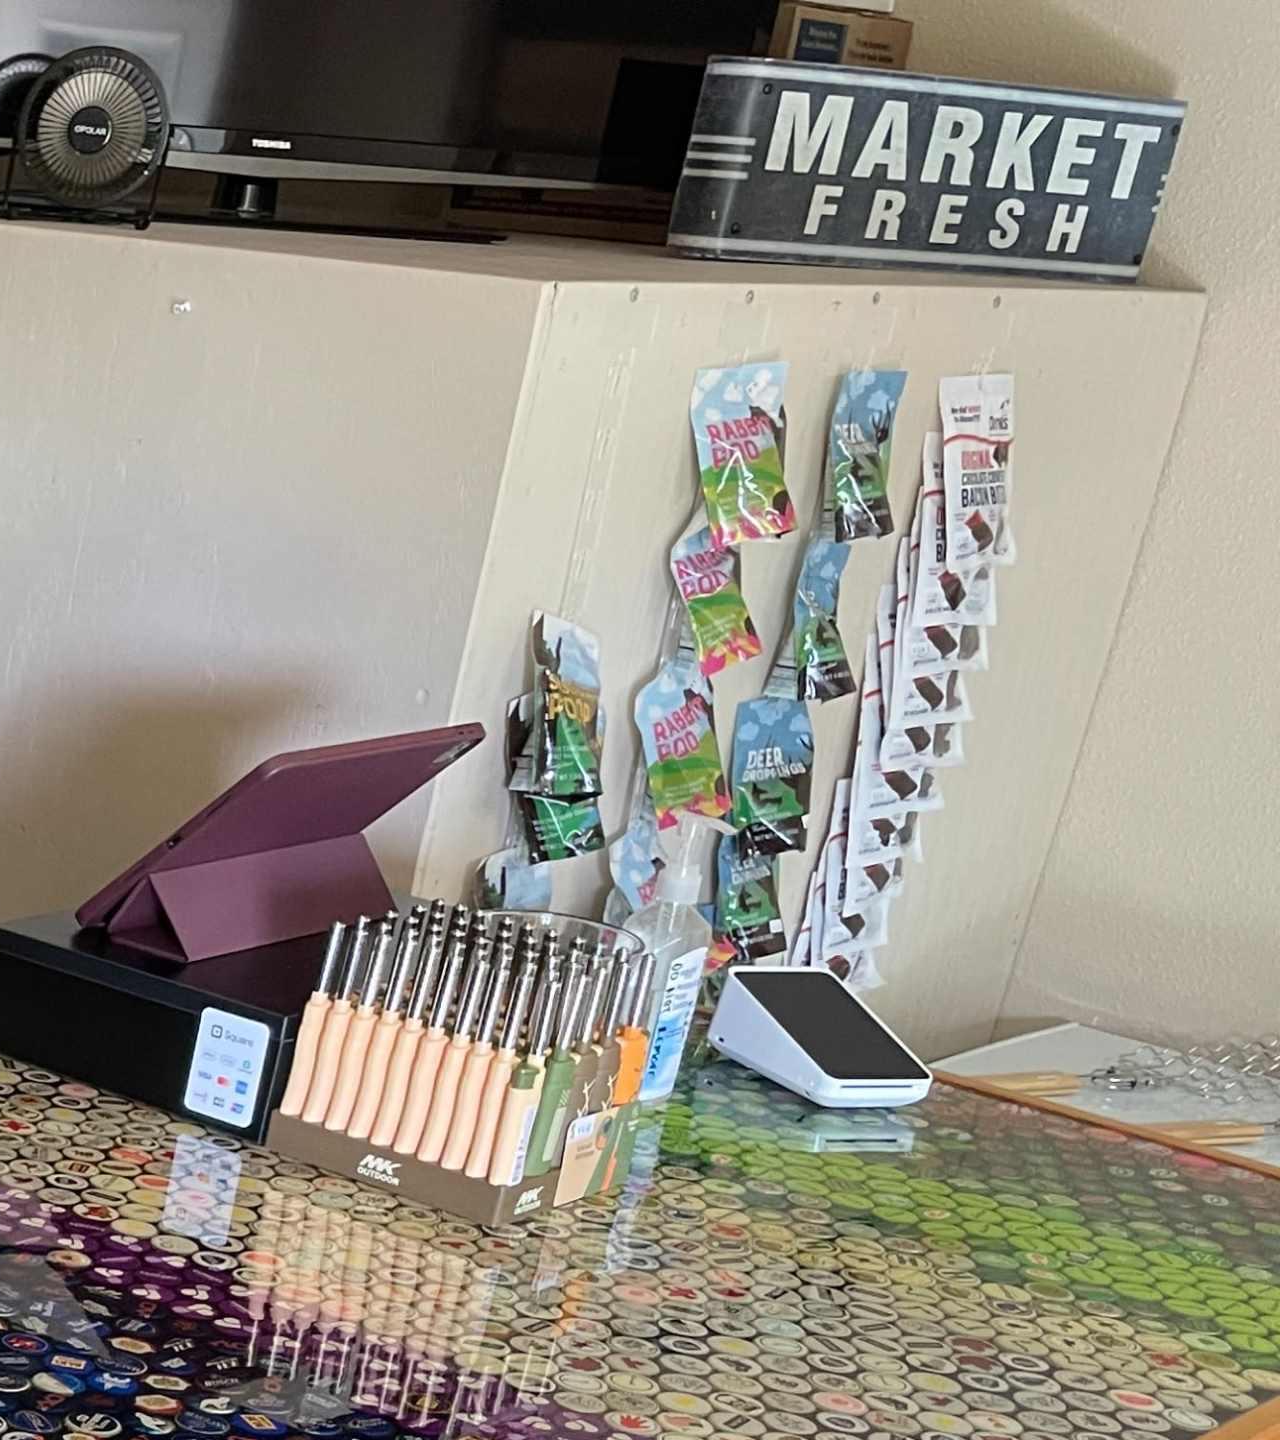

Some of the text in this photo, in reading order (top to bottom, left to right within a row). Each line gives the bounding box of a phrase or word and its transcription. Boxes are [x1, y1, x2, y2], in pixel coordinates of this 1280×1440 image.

[764, 90, 1162, 200] MARKET
[803, 184, 1089, 254] FRESH
[356, 1166, 400, 1186] OUTDOOR
